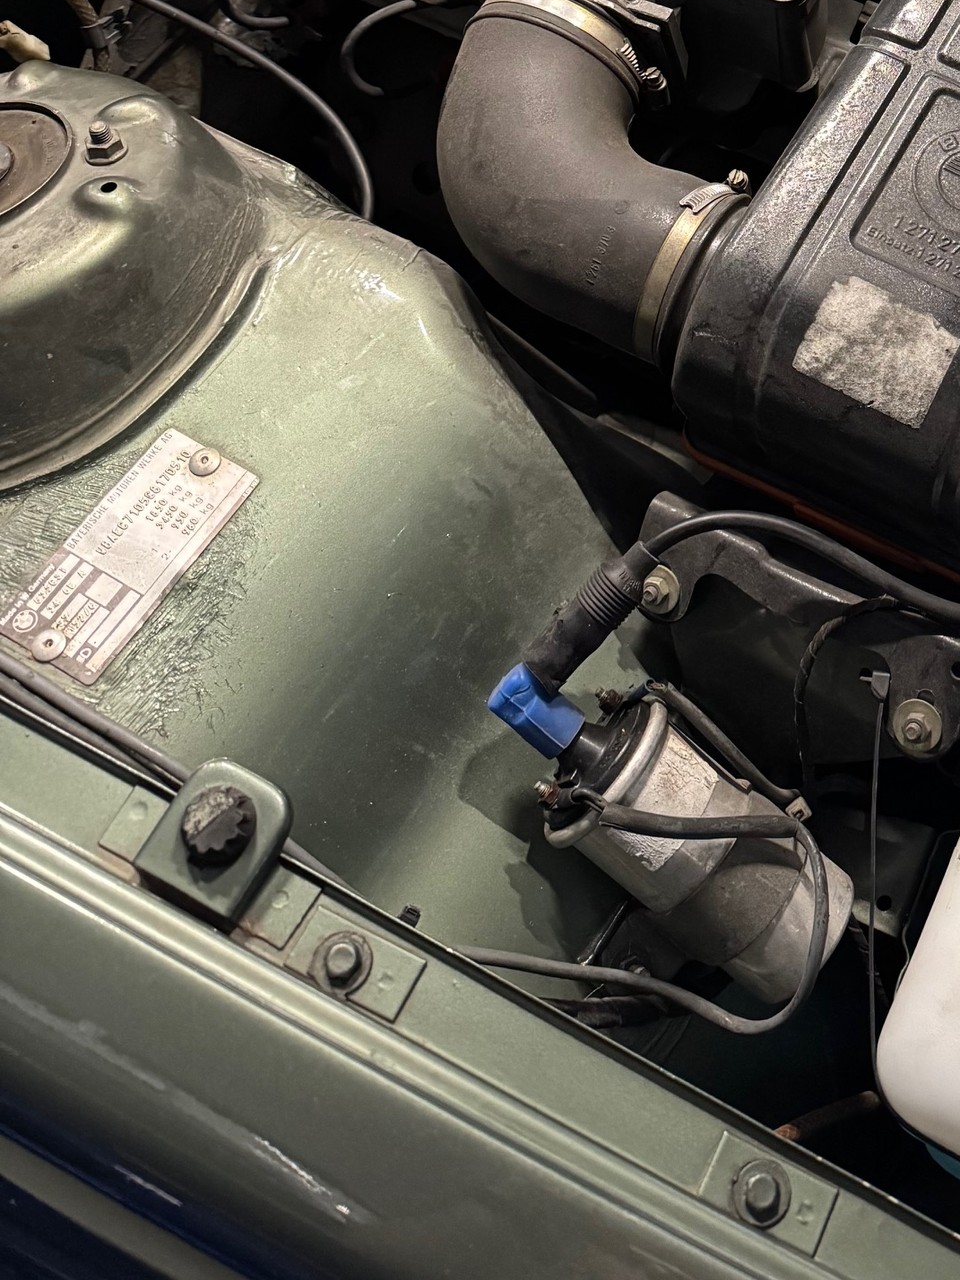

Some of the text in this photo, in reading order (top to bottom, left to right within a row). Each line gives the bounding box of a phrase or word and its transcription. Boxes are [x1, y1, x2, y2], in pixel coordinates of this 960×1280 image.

[904, 220, 938, 245] 271
[66, 431, 173, 550] BAYERISCHE MOTOREN WERKE AG
[167, 482, 184, 498] kg
[177, 488, 194, 504] kg
[187, 494, 204, 510] kg
[198, 500, 215, 516] kg
